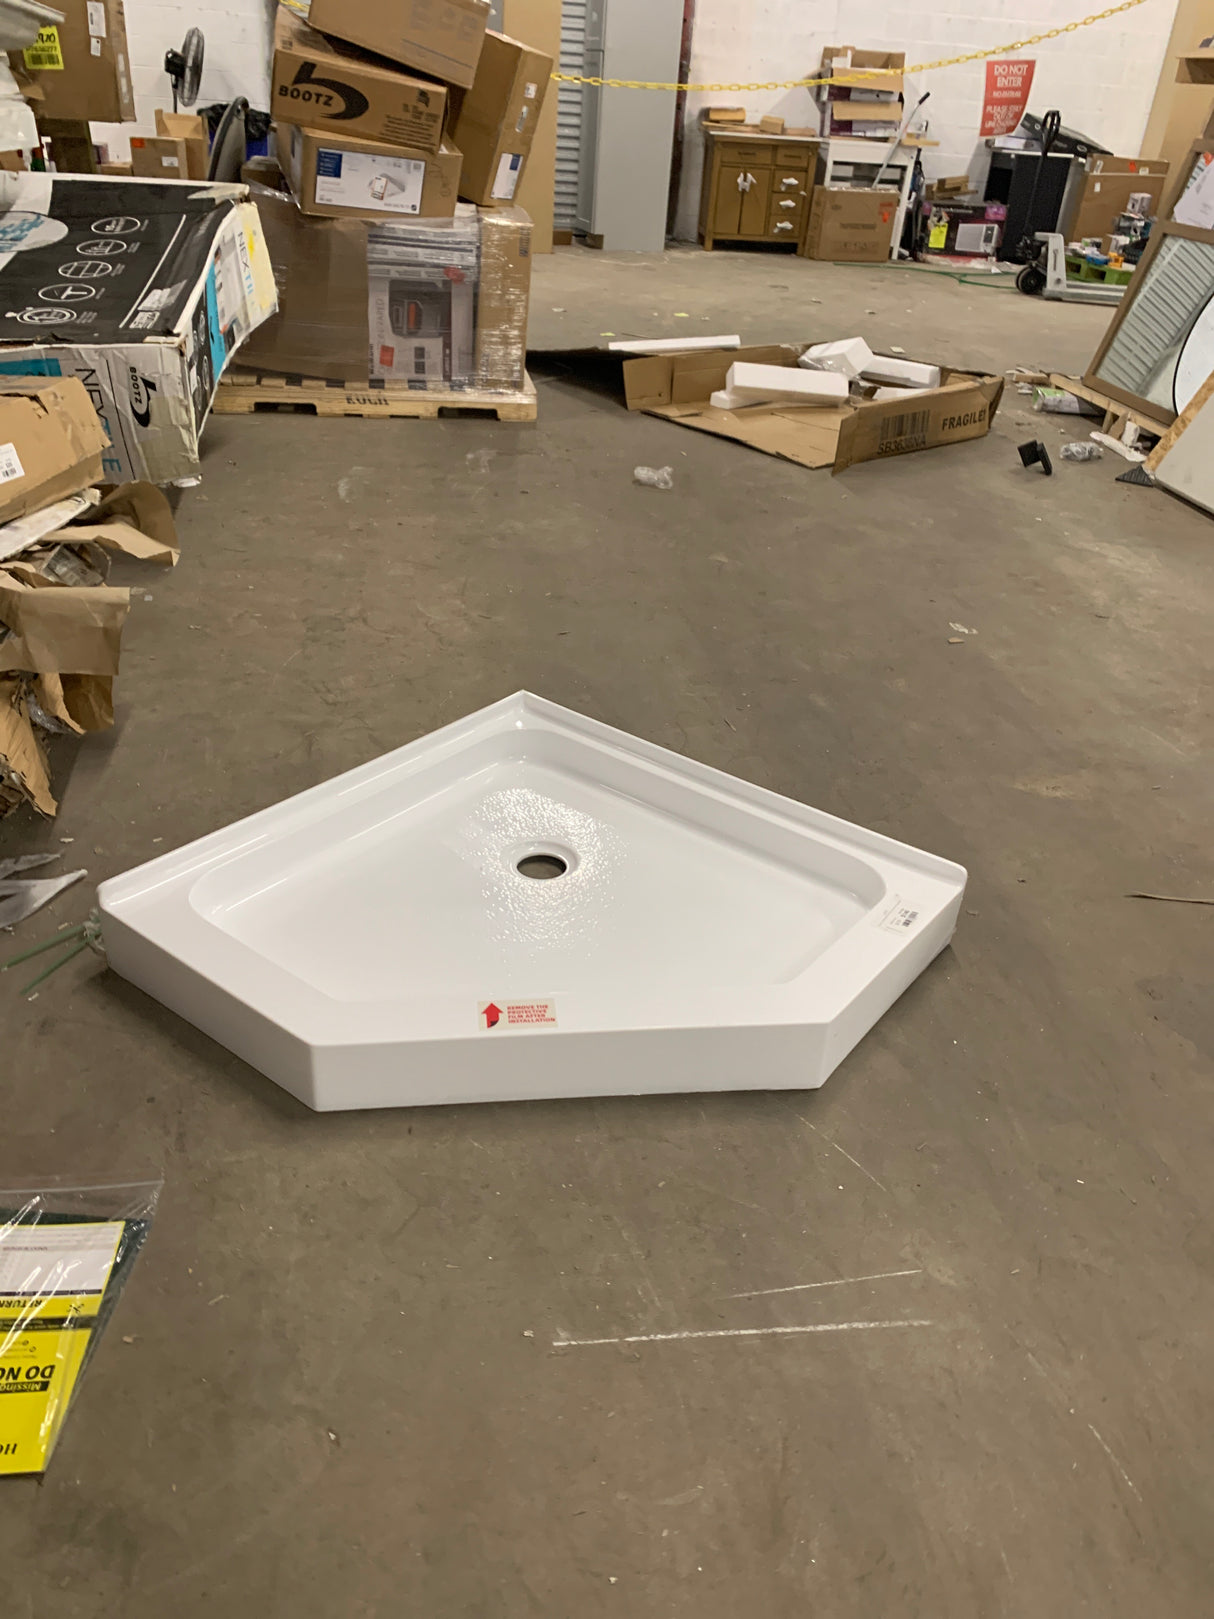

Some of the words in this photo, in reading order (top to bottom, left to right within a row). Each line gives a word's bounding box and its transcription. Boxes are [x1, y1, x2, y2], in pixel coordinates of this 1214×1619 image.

[994, 64, 1008, 76] DO
[1009, 64, 1028, 75] NOT
[997, 76, 1022, 88] ENTER
[278, 85, 335, 107] BOOTZ
[129, 366, 143, 405] BOOTZ
[942, 408, 987, 431] FRAGILE!
[25, 1364, 56, 1381] DO
